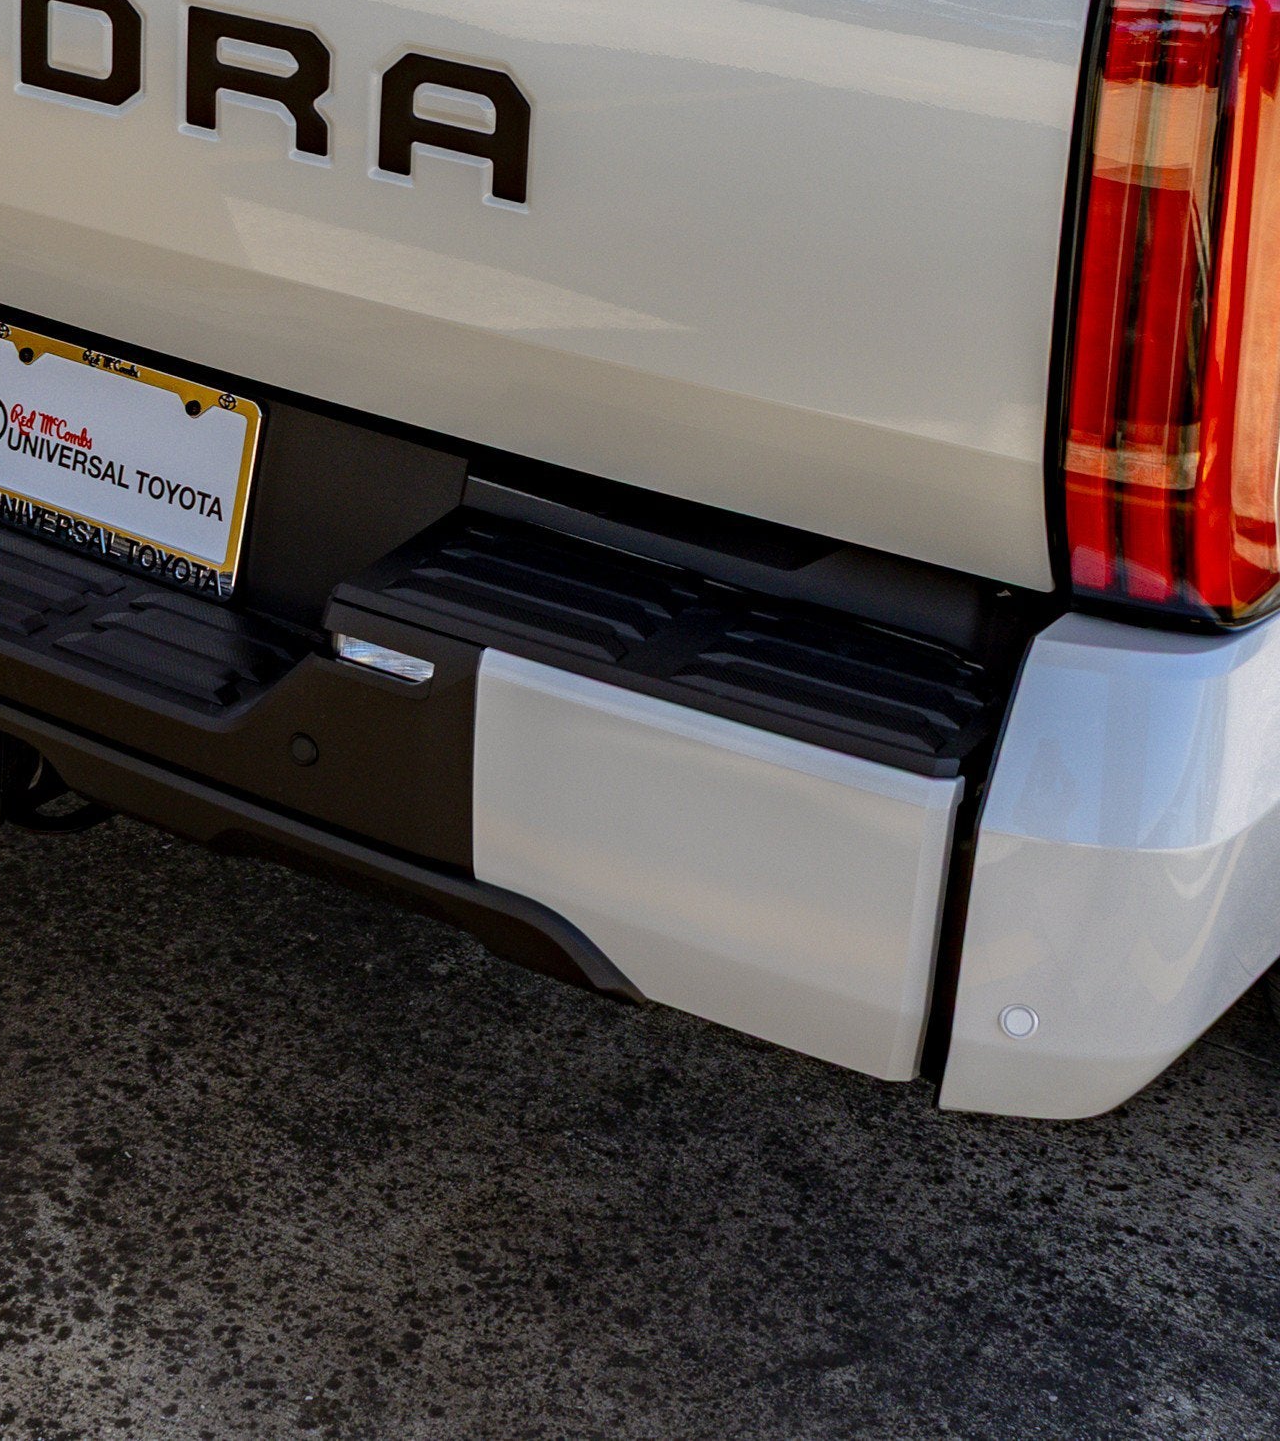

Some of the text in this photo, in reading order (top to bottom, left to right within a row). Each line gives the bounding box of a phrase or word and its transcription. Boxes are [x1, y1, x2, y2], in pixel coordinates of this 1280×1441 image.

[10, 404, 93, 450] Red McCombs
[8, 427, 224, 522] UNIVERSAL TOYOTA
[126, 537, 221, 597] TOYOTA
